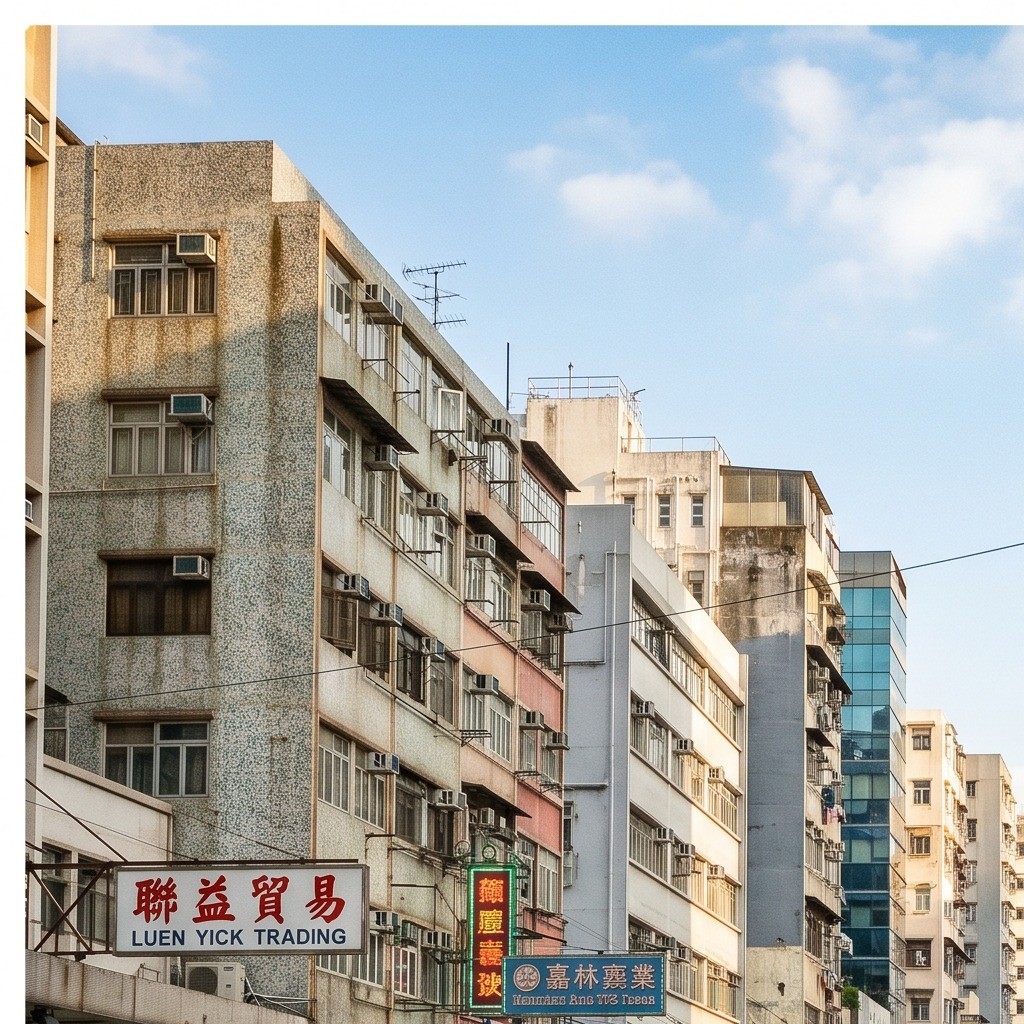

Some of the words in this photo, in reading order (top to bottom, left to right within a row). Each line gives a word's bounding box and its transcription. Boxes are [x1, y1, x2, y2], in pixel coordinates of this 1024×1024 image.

[133, 875, 346, 925] 聯益貿易
[132, 930, 185, 947] LUEN
[196, 929, 244, 946] YICK
[254, 929, 346, 945] TRADING
